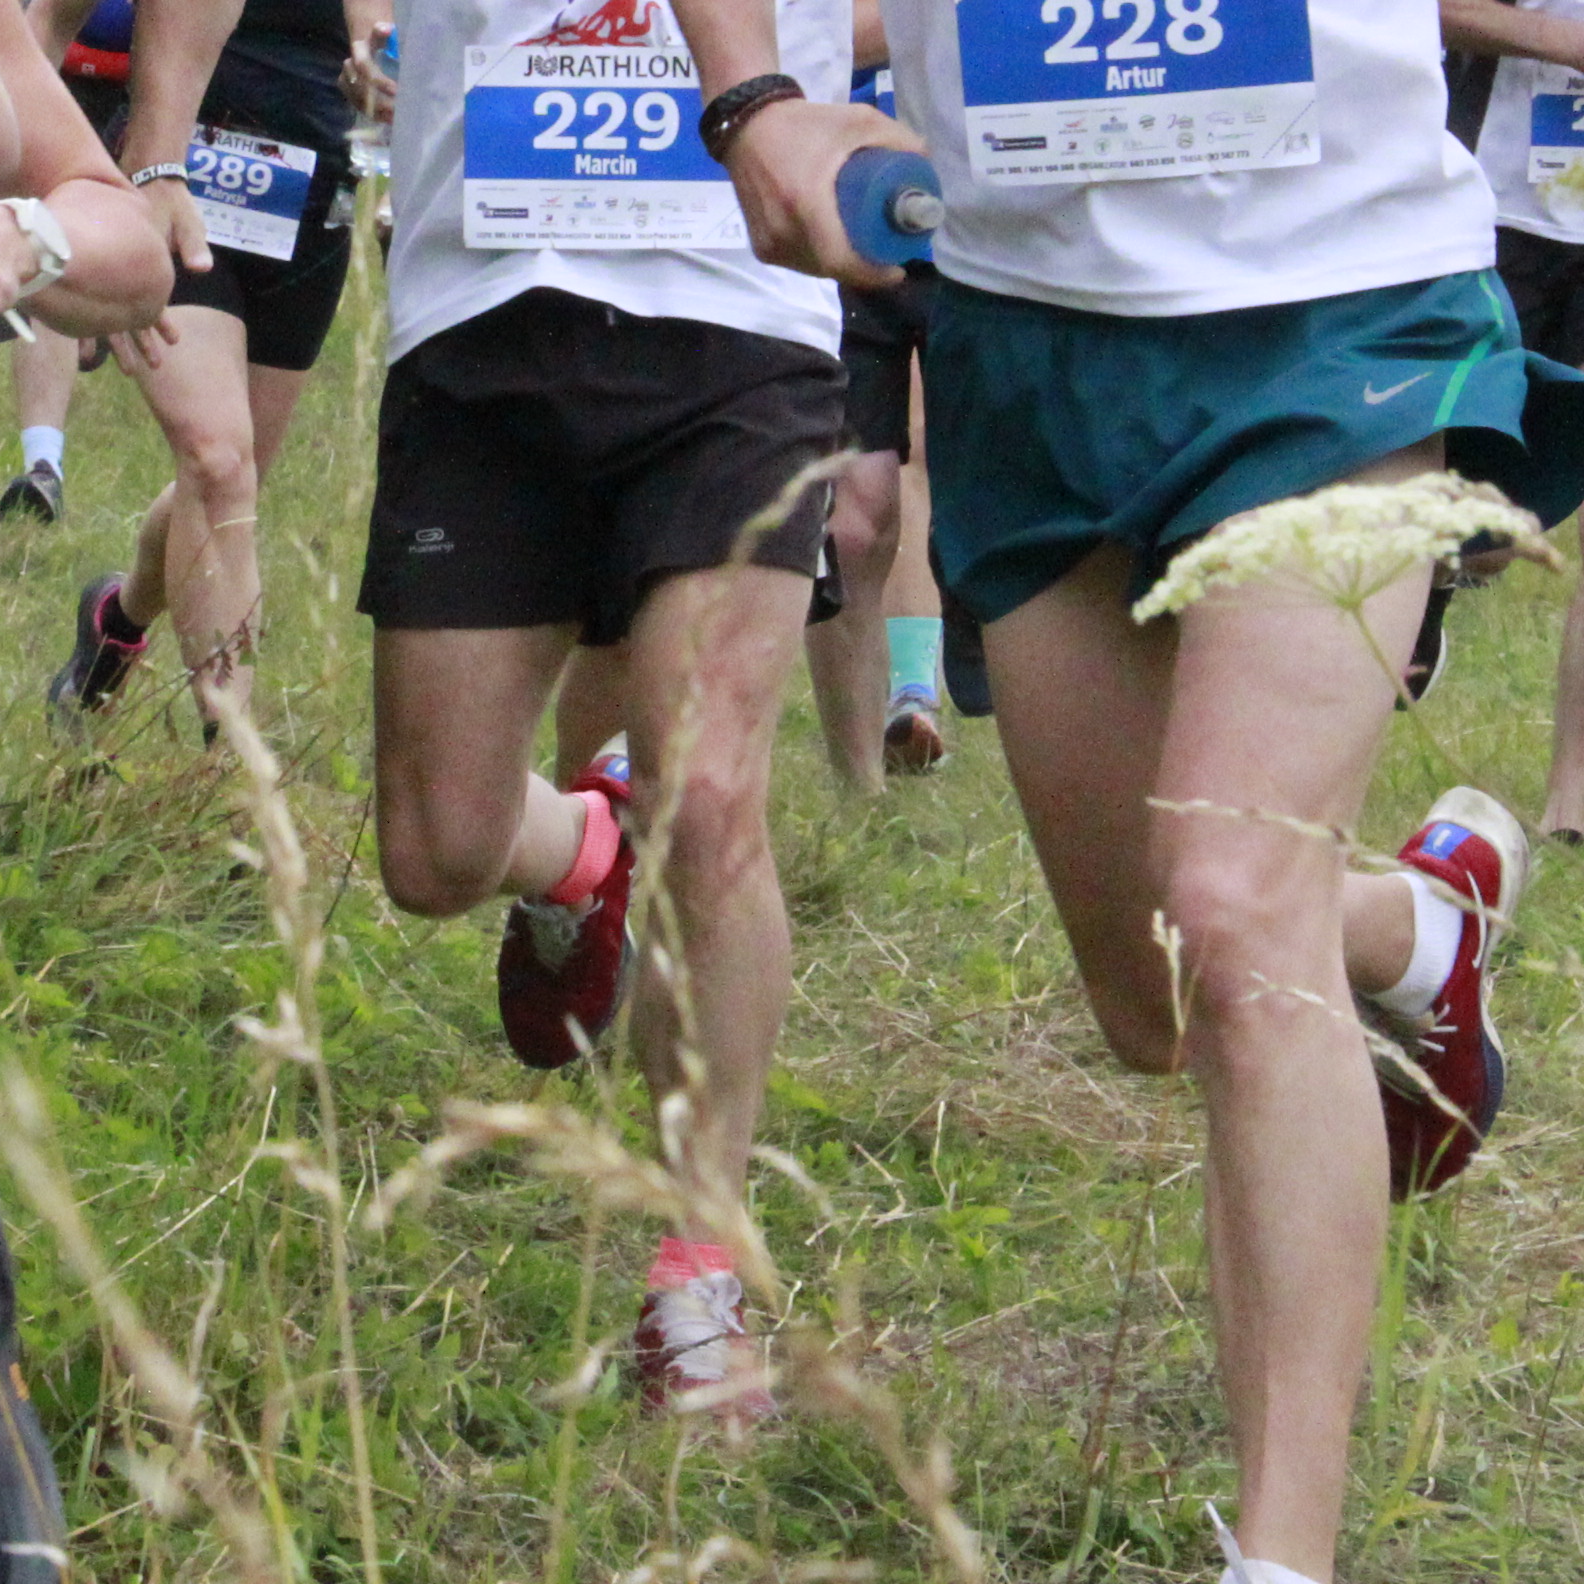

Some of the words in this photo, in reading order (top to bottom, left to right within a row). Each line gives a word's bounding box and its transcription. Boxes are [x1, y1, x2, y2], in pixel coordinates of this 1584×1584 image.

[1105, 64, 1167, 92] Artur
[531, 90, 681, 152] 229
[188, 148, 273, 196] 289
[575, 154, 637, 176] Marcin
